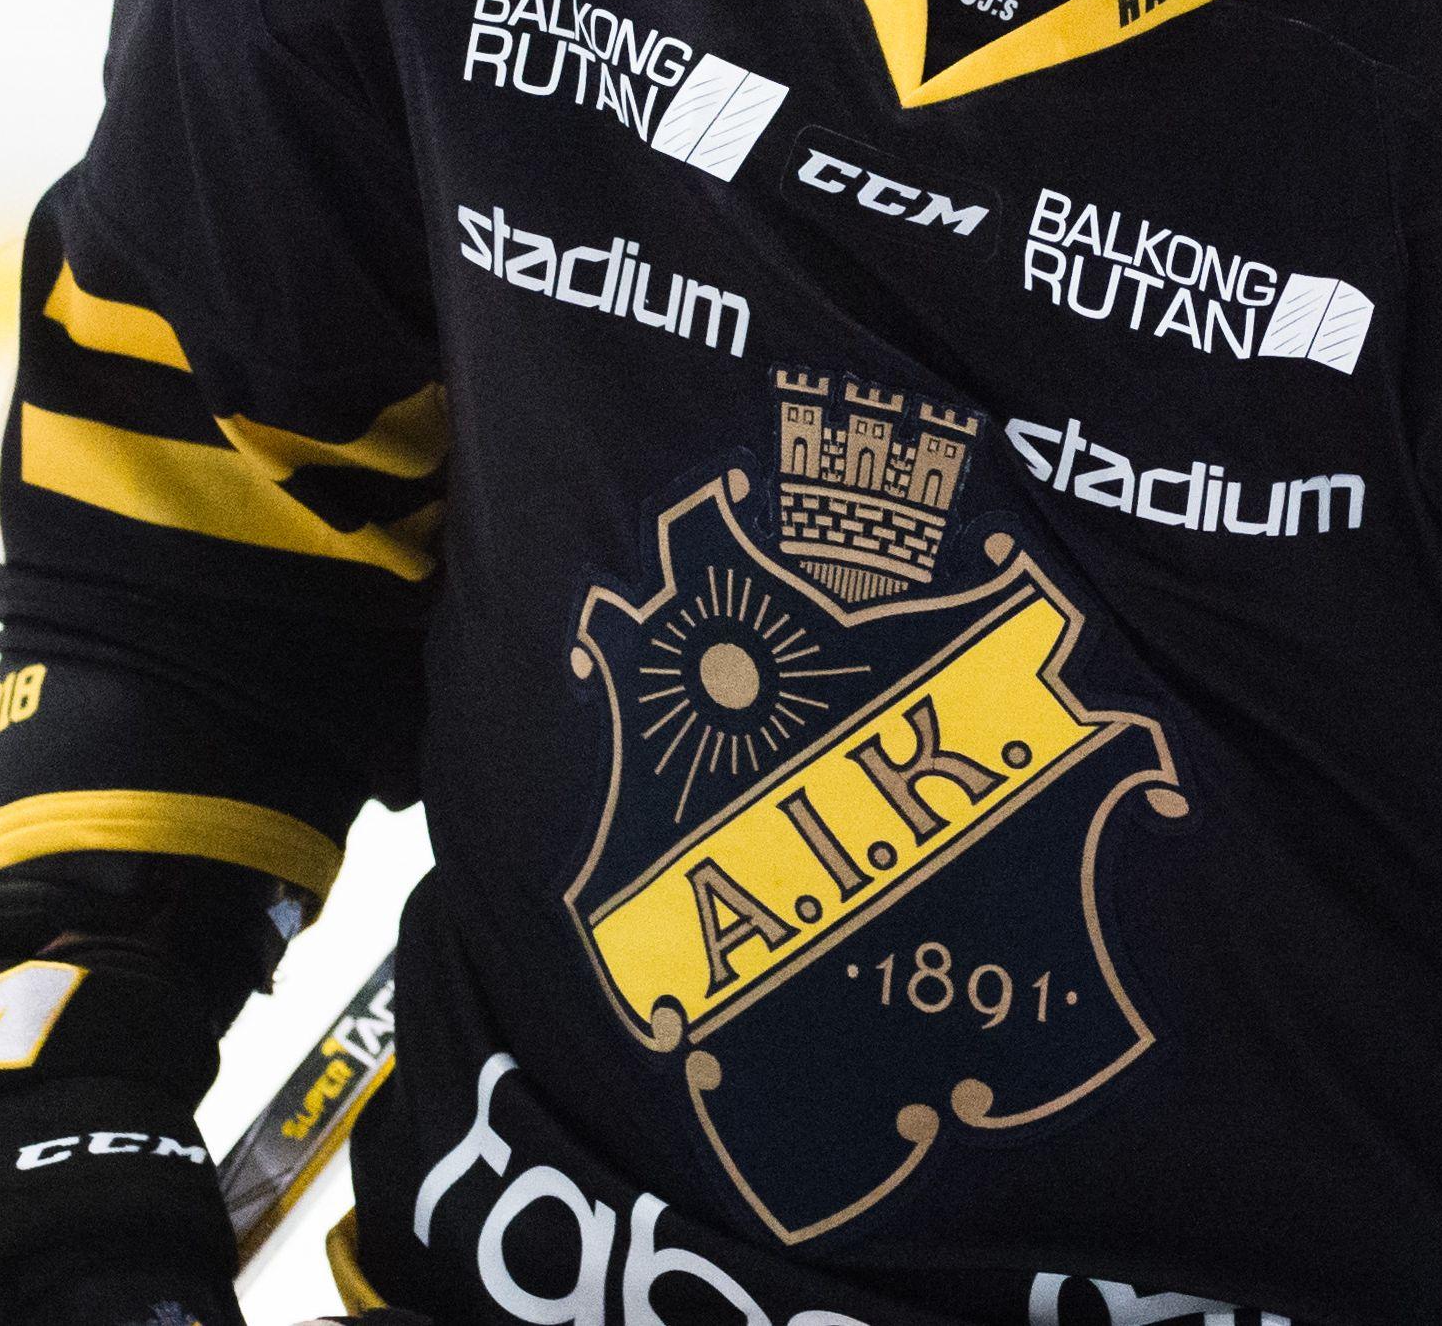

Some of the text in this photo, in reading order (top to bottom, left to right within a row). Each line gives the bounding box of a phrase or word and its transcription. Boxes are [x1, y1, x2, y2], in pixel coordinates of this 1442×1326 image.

[463, 24, 659, 143] RUTAN
[797, 148, 989, 236] CCM
[1028, 187, 1278, 307] BALKONG
[458, 204, 751, 358] stadium
[1024, 239, 1256, 360] RUTAN
[1004, 418, 1366, 537] stadium
[685, 693, 1034, 999] A.I.K.
[15, 1131, 206, 1171] CCM
